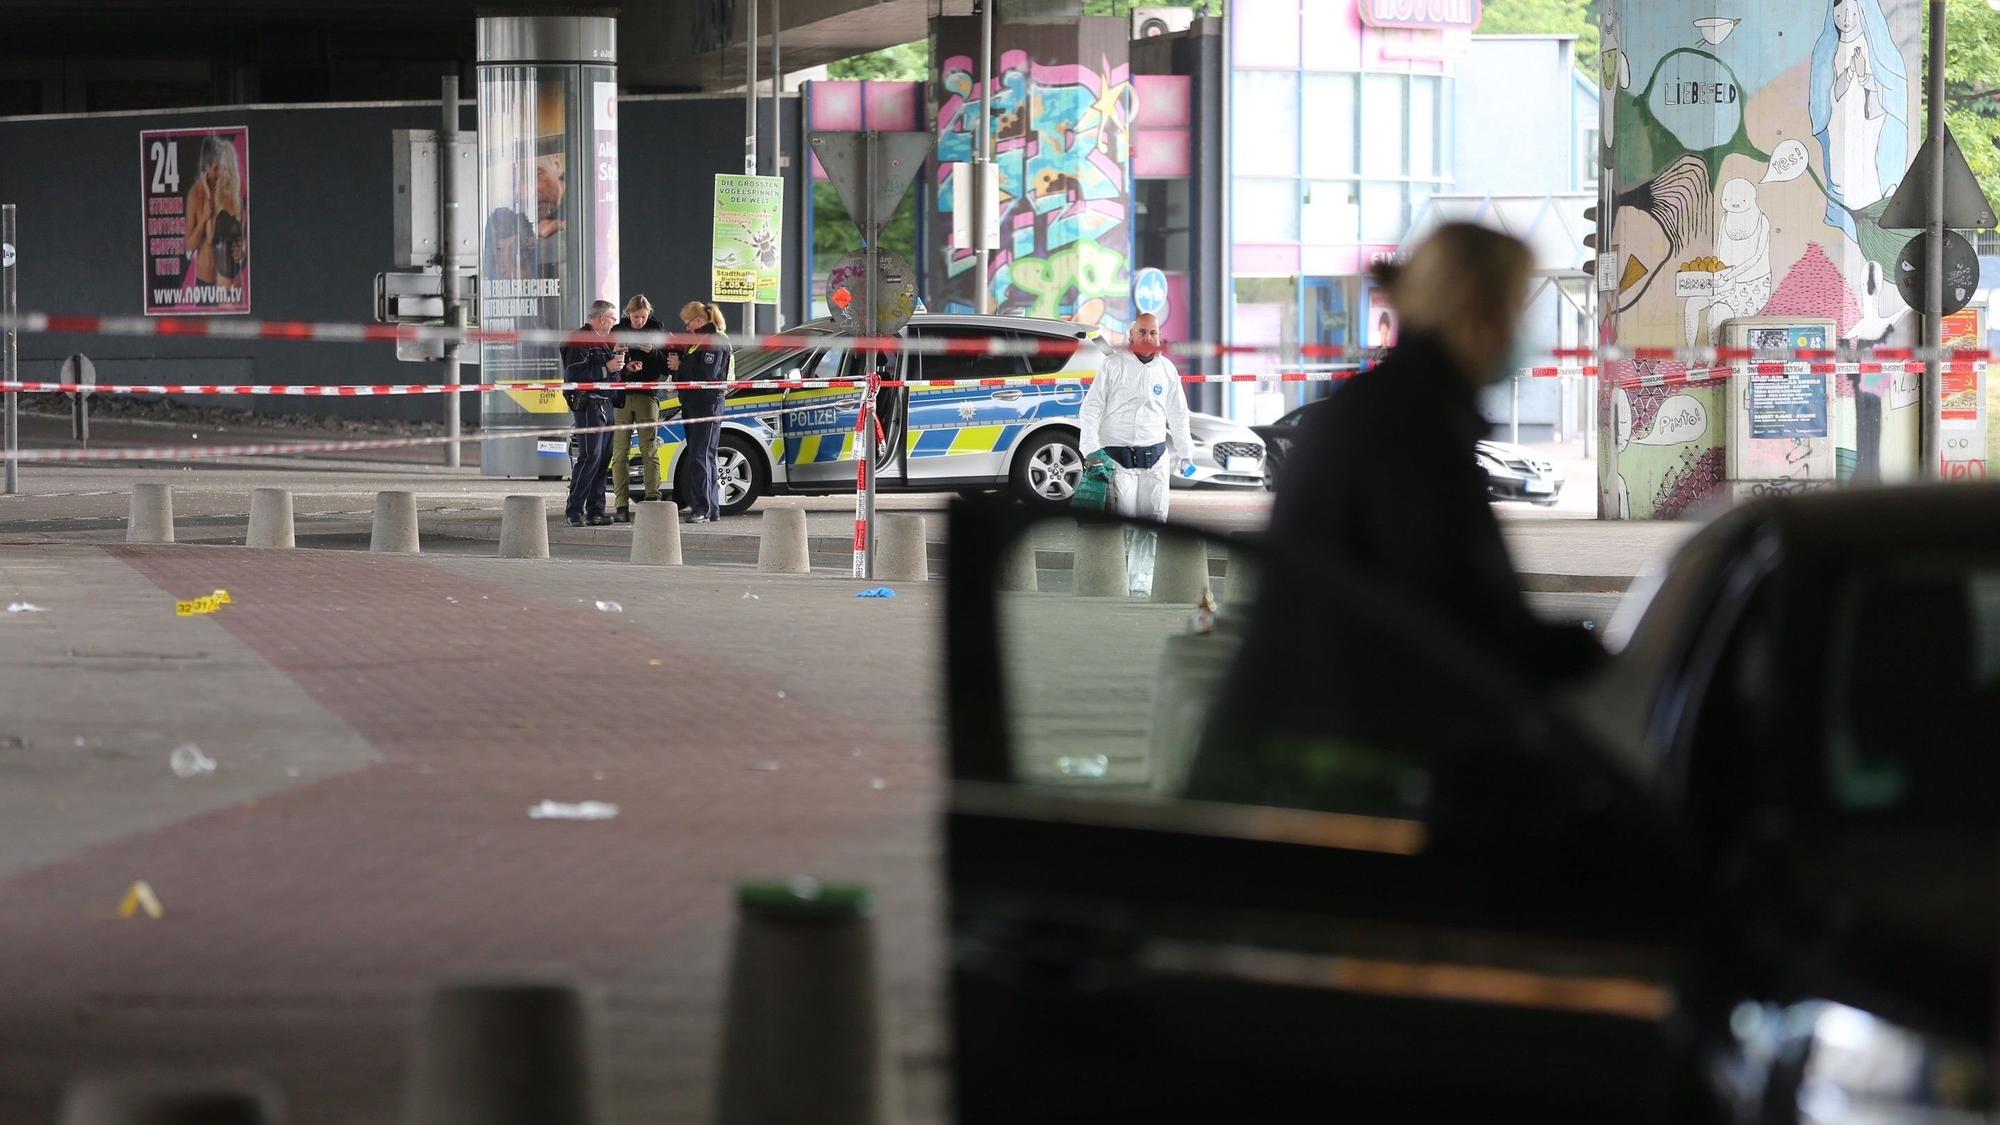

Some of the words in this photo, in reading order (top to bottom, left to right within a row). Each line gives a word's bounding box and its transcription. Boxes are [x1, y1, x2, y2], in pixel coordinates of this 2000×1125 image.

[150, 141, 180, 194] 24
[154, 285, 243, 305] www.novum.tv
[715, 288, 755, 298] Sonntag
[789, 408, 837, 428] POLIZEI
